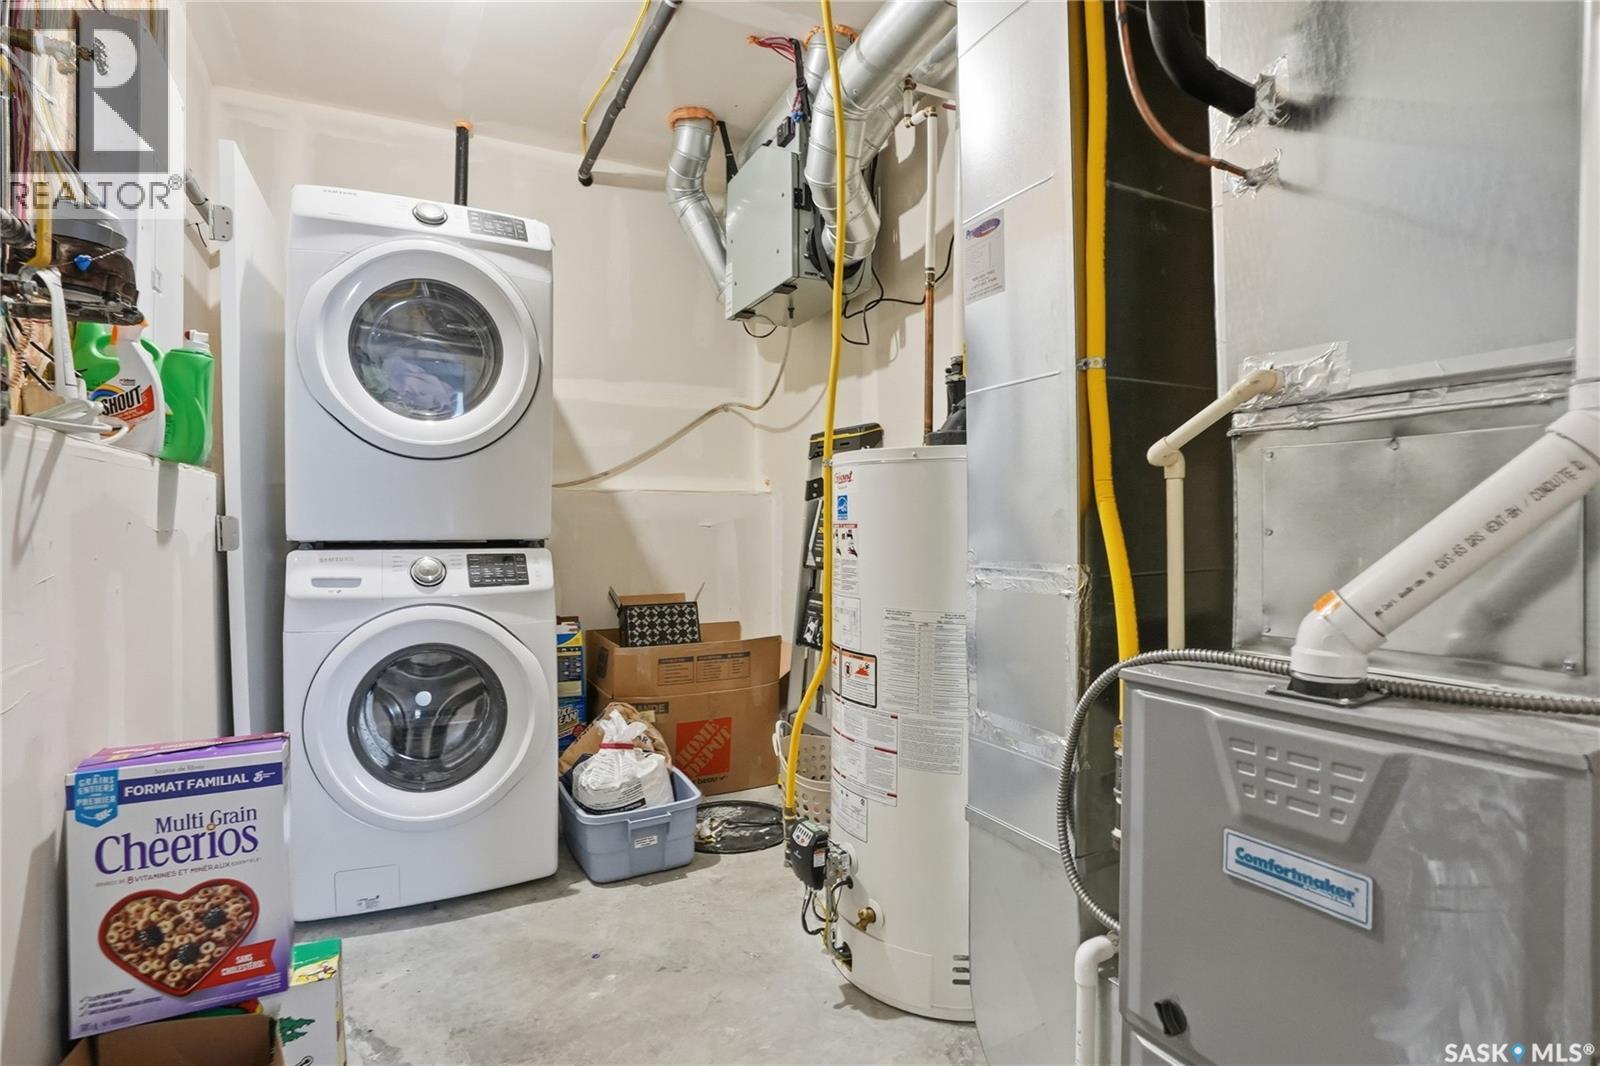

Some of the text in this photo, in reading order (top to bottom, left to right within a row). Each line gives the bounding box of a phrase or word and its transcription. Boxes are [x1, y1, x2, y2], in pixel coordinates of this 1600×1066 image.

[100, 384, 142, 417] SHOUT
[677, 719, 720, 768] HOME
[687, 726, 732, 778] DEPOT
[124, 780, 185, 797] FORMAT
[187, 773, 249, 791] FAMILIAL
[155, 807, 257, 834] Multi Grain
[95, 823, 259, 875] Cheerios
[127, 875, 134, 885] 8
[135, 870, 177, 882] VITAMINES
[178, 868, 188, 877] ET
[1235, 847, 1356, 901] Comfortmaker
